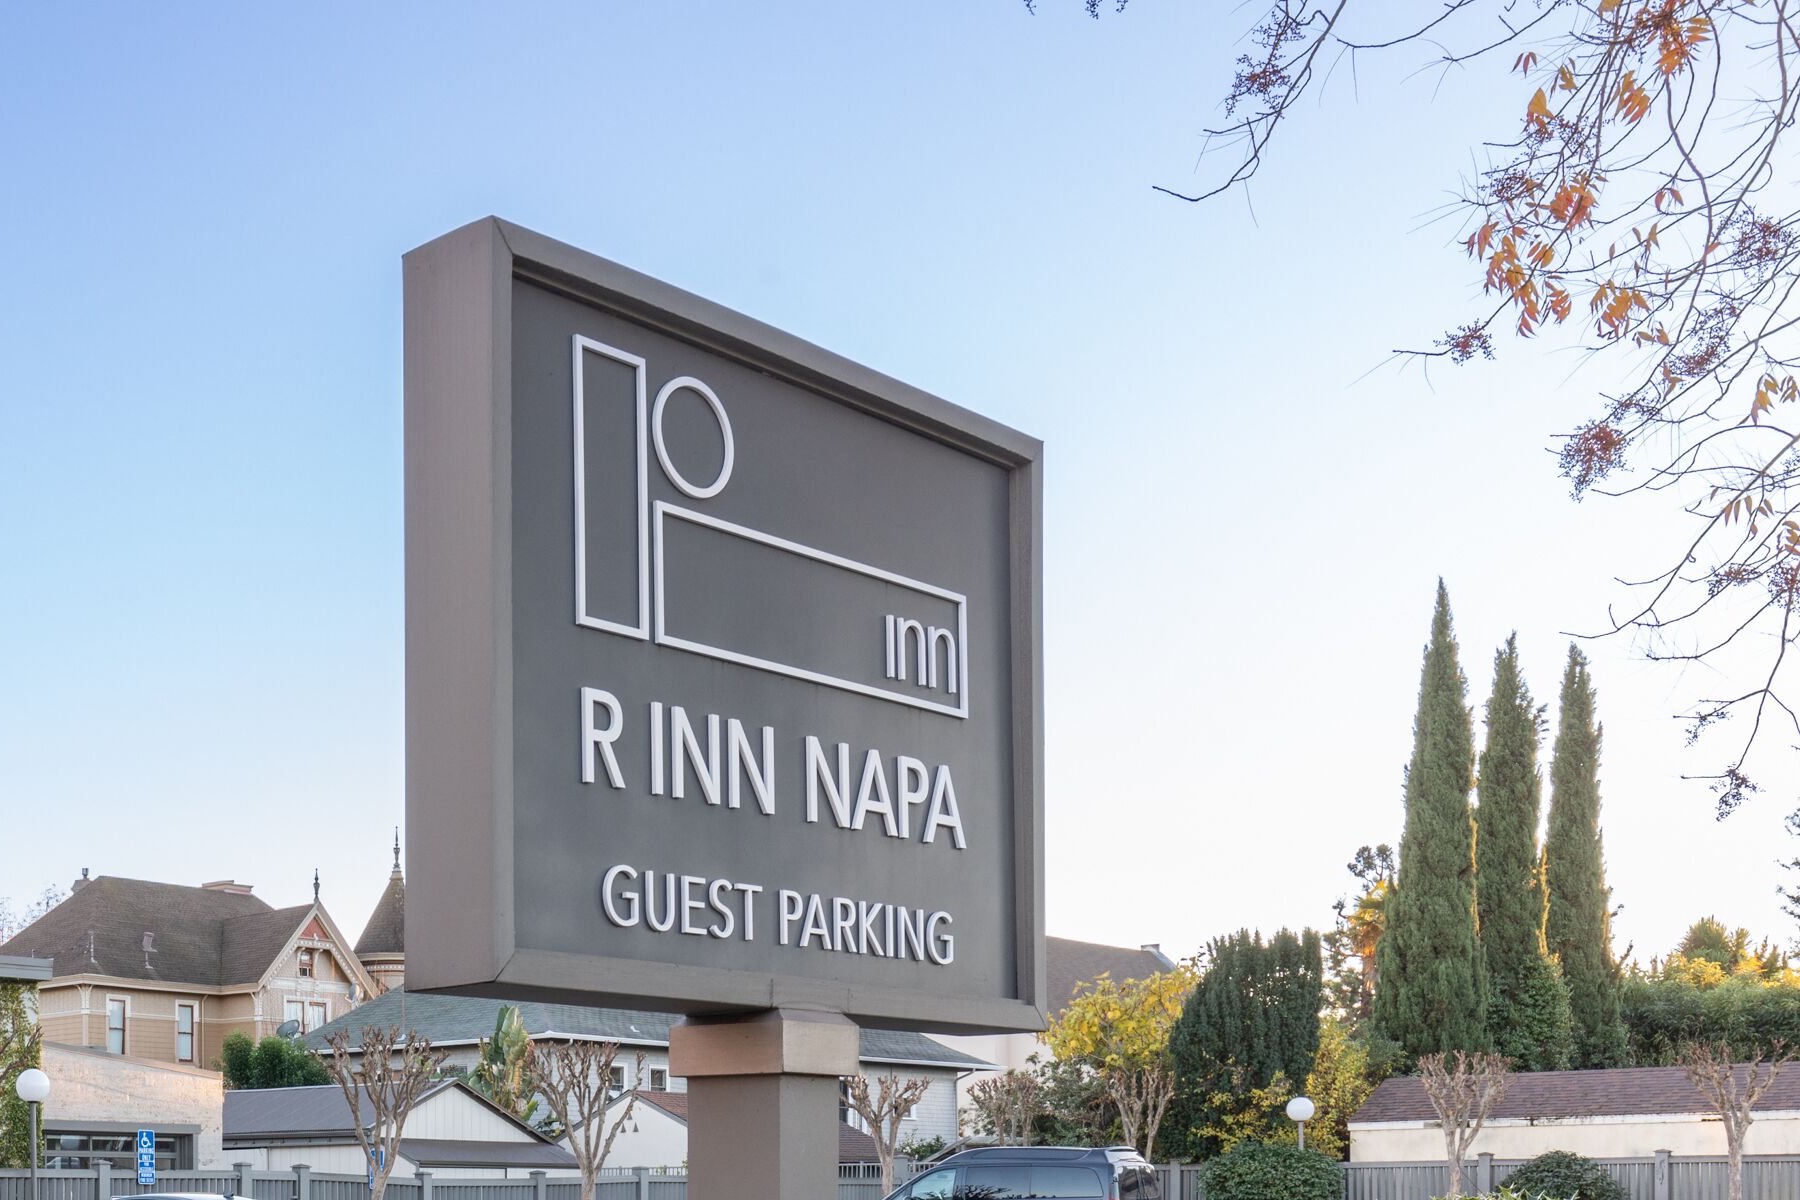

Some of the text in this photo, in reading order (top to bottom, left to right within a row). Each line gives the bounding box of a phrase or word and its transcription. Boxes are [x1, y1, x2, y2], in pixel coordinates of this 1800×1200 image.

[580, 686, 967, 849] R INN NAPA
[602, 864, 954, 965] GUEST PARKING
